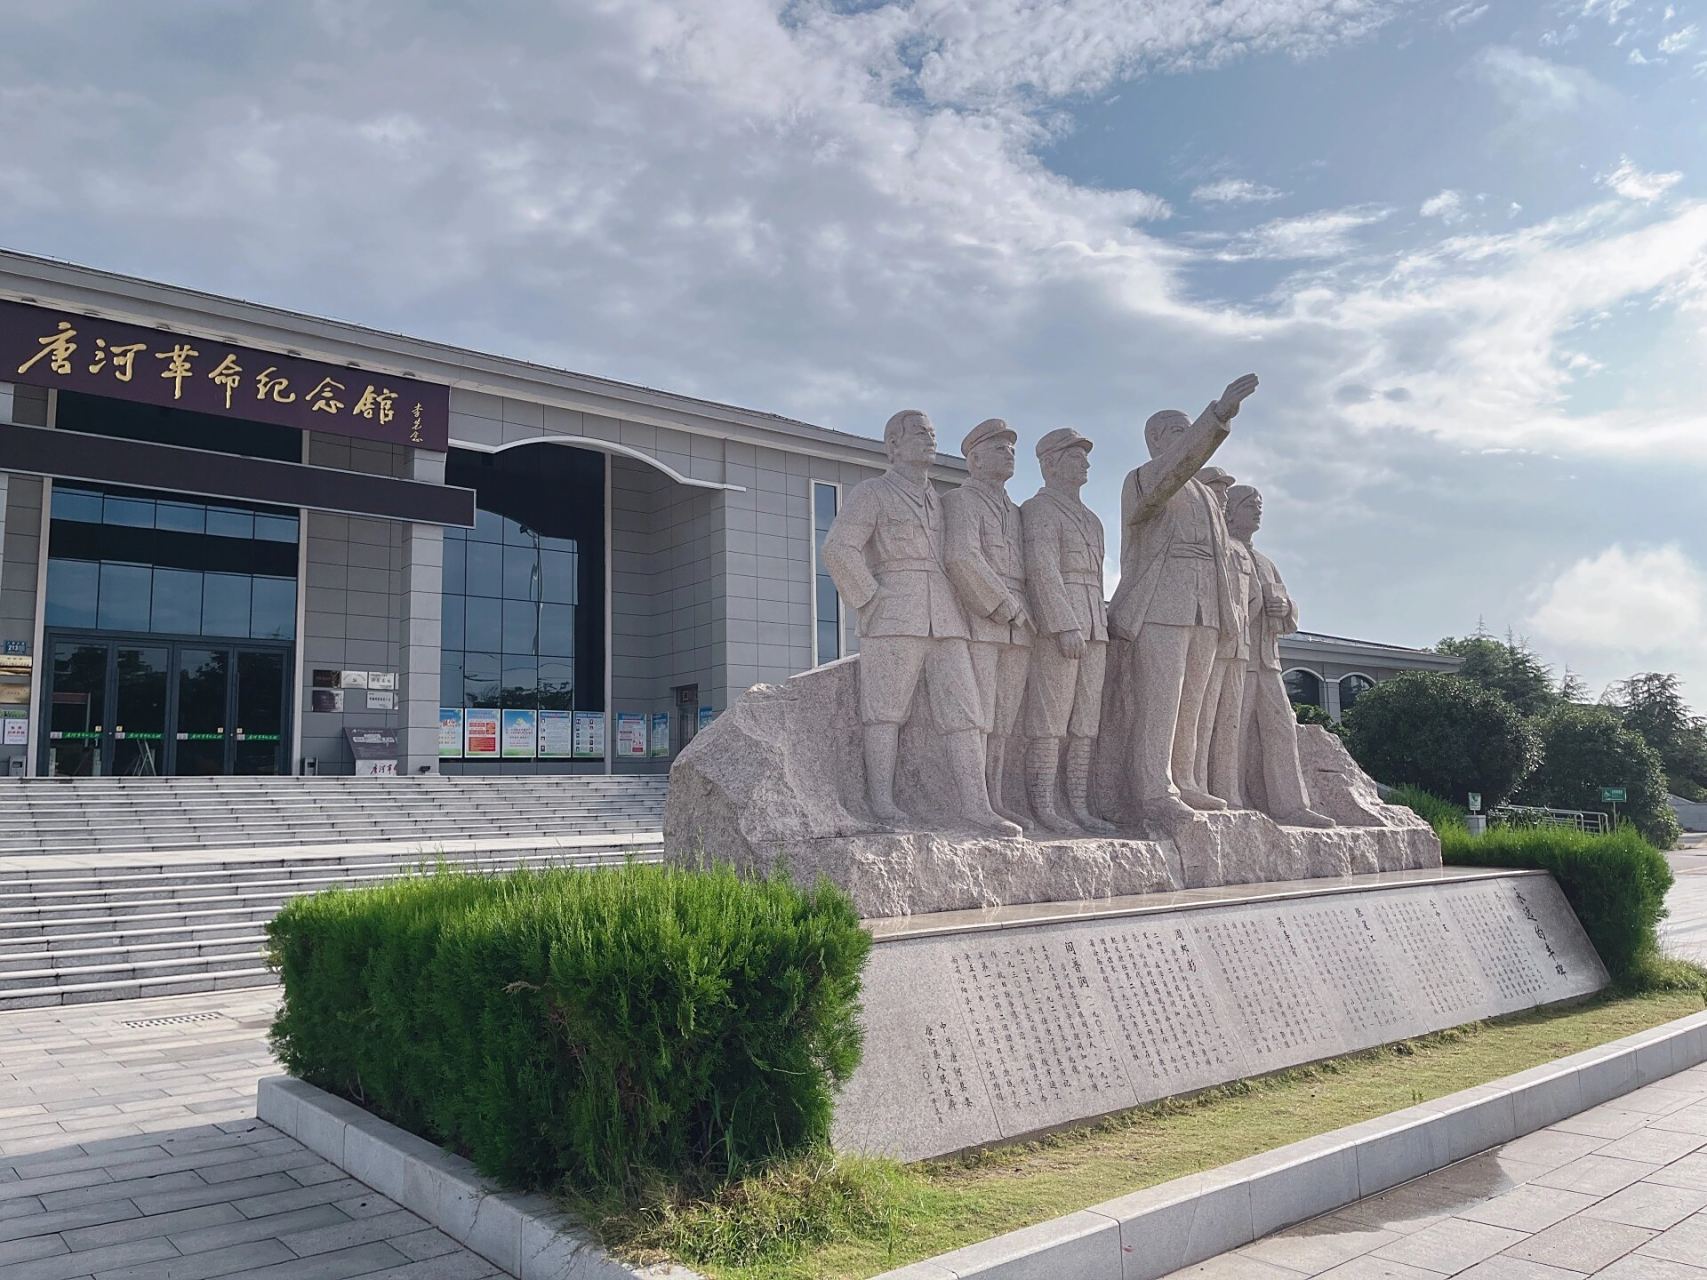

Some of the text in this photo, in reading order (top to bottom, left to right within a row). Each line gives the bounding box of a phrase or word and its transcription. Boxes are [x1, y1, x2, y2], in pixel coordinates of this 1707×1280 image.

[1511, 887, 1568, 979] 永远的丰碑
